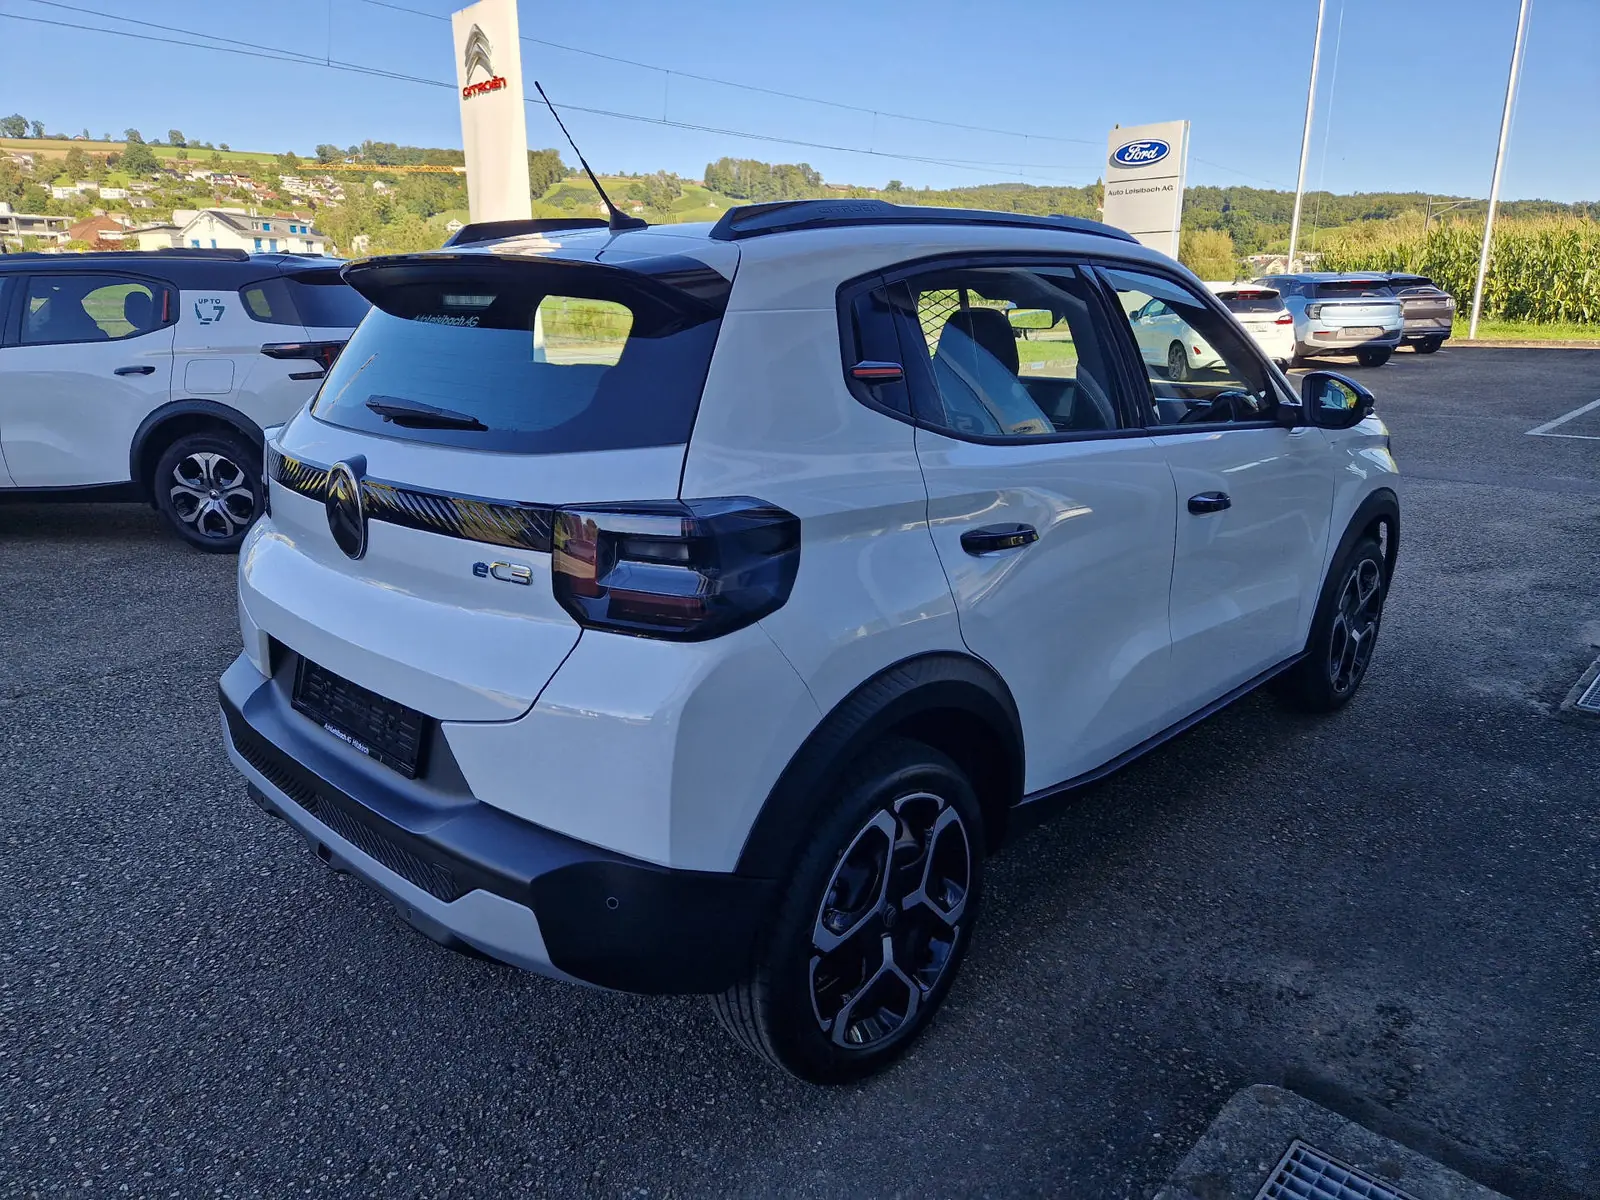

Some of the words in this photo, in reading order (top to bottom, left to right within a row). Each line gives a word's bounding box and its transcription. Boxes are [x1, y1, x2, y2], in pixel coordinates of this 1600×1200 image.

[1124, 143, 1159, 161] Ford
[1125, 186, 1160, 195] Leisibach
[1162, 184, 1174, 192] AG
